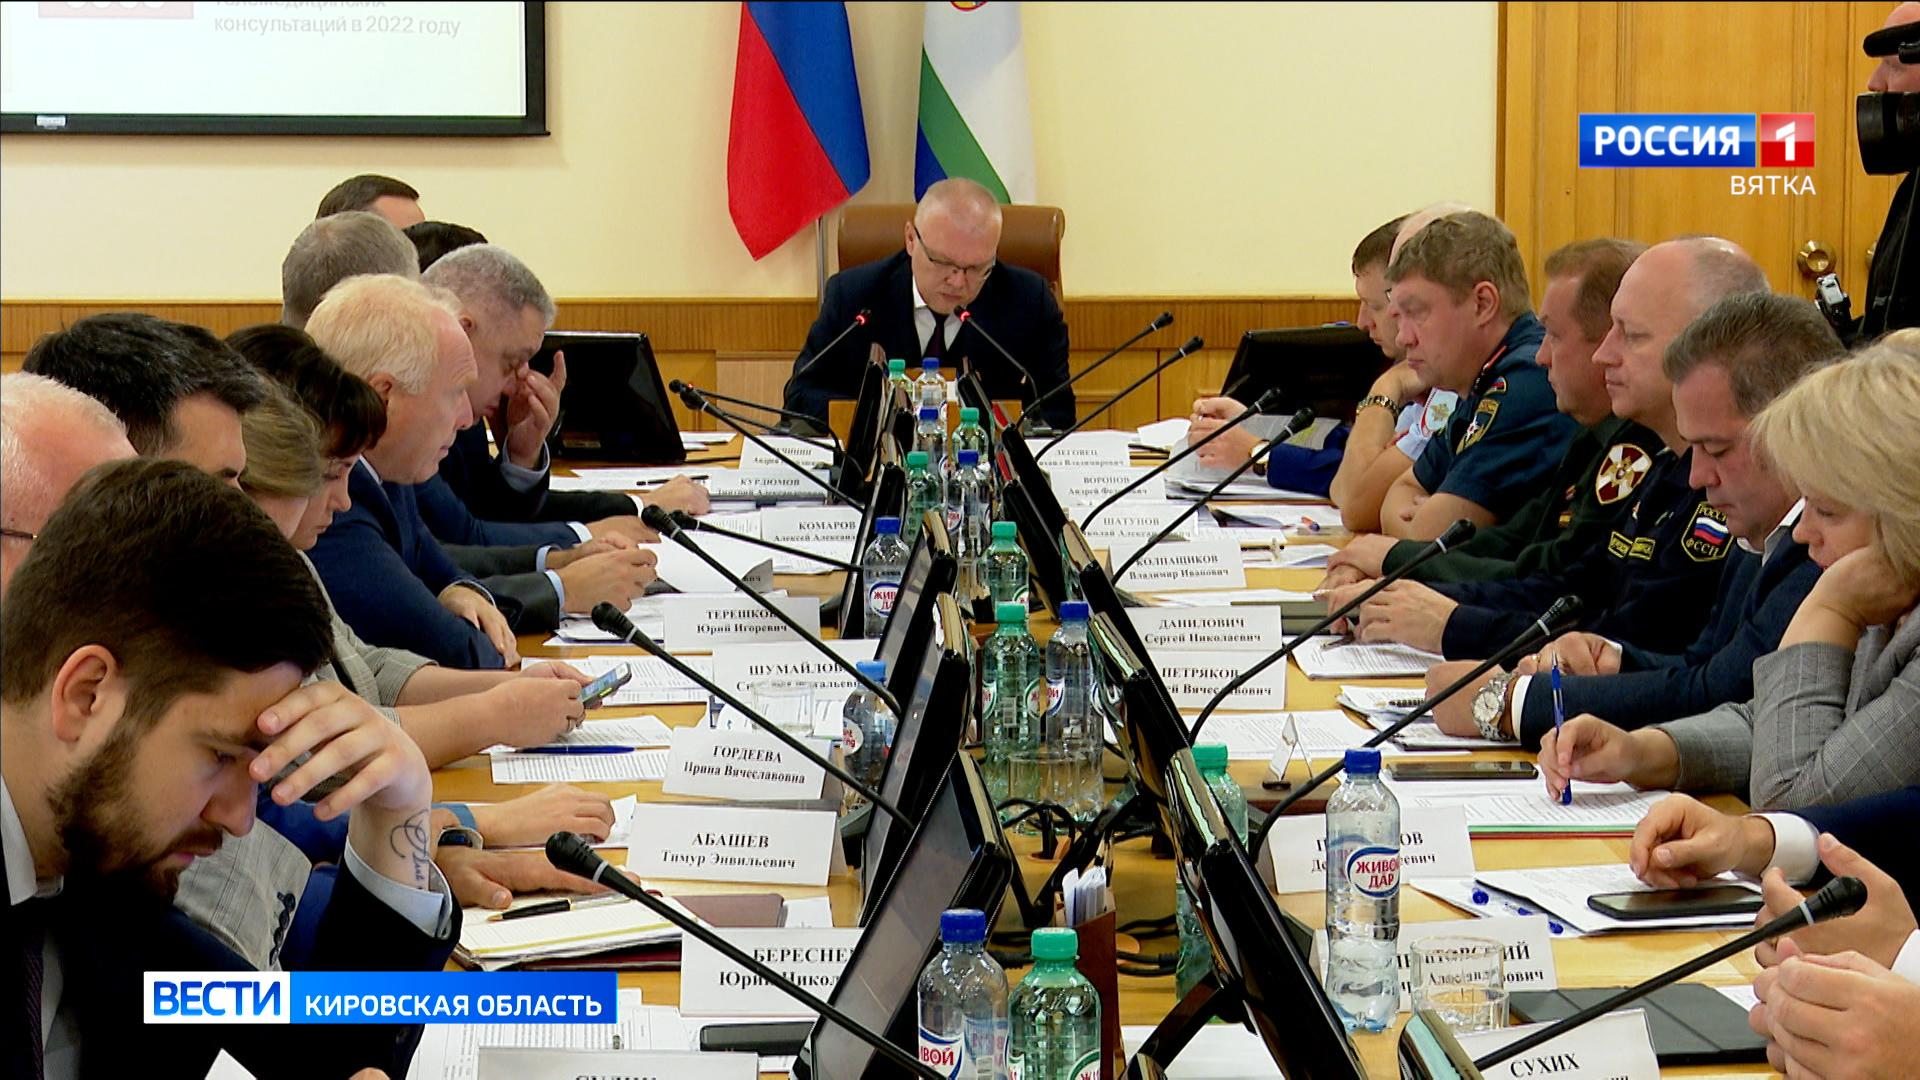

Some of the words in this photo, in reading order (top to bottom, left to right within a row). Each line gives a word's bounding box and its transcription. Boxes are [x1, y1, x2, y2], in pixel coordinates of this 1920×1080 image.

[214, 16, 347, 36] консультаций
[352, 19, 362, 32] в
[366, 16, 414, 34] 2022
[419, 20, 461, 38] году
[798, 521, 856, 530] КОМАРОВ
[1103, 517, 1160, 526] ШАТУНОВ
[1129, 570, 1179, 581] Владимир
[1181, 568, 1229, 579] Иванович
[696, 623, 731, 635] Юрий
[734, 623, 788, 635] Игоревич
[1158, 617, 1245, 630] ДАНИЛОВИЧ
[1144, 633, 1186, 646] Сергей
[1189, 632, 1261, 643] Николаевич
[749, 661, 846, 676] ШУМАЙЛОВ
[712, 744, 783, 764] ГОРДЕЕВА
[683, 760, 721, 777] Ирина
[724, 764, 806, 784] Вячеславовна
[692, 832, 770, 849] АБАШЕВ
[661, 850, 706, 867] Тимур
[709, 852, 796, 869] Энвильевич
[1368, 873, 1394, 889] ДАР
[753, 948, 855, 963] БЕРЕСНЕ
[1510, 1053, 1580, 1078] СУХИХ
